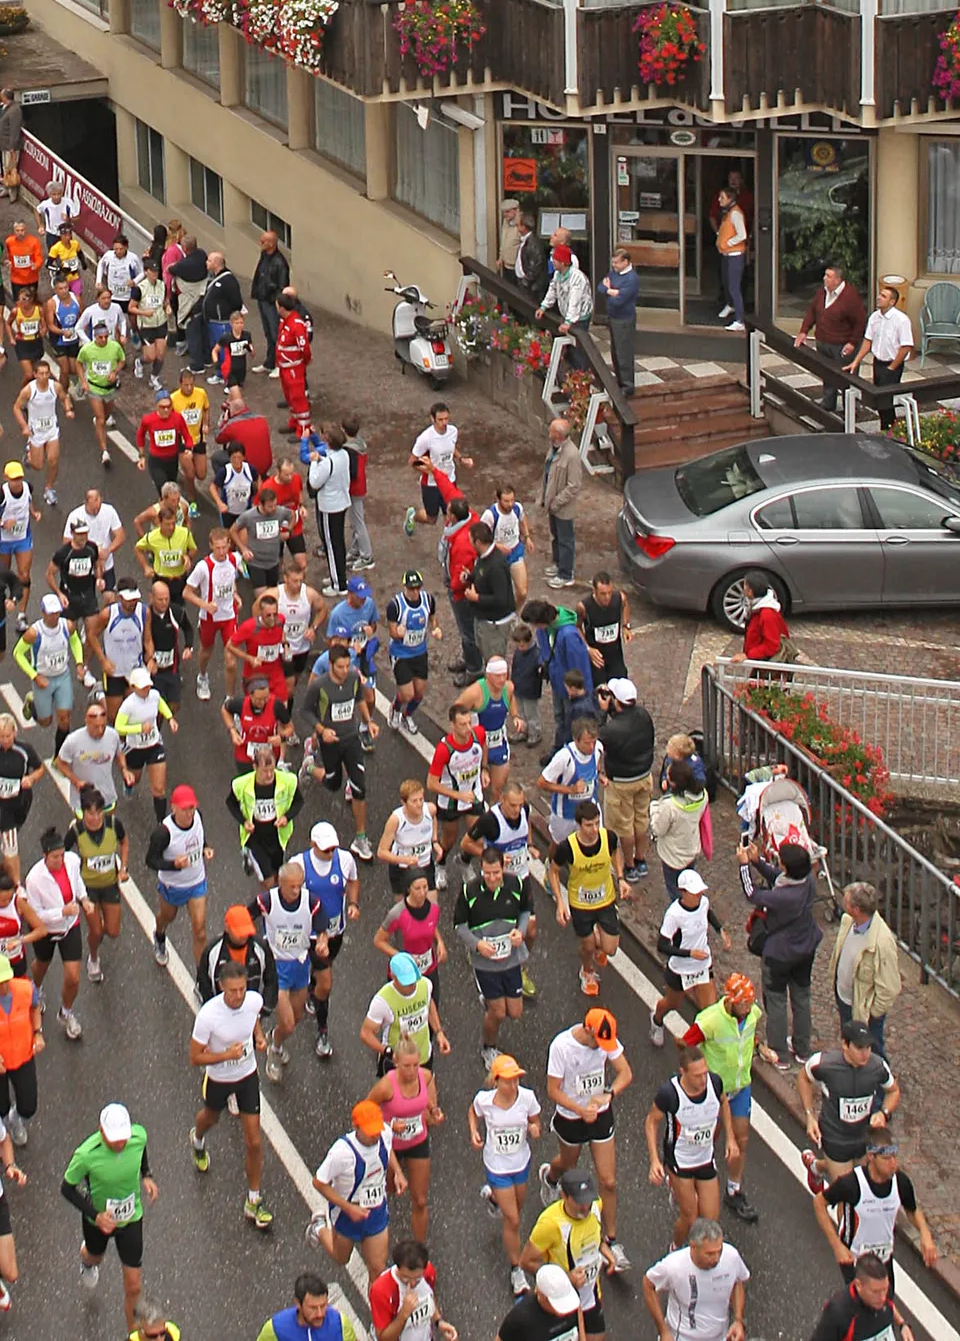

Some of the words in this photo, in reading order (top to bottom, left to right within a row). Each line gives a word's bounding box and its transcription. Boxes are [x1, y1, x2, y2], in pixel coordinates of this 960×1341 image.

[407, 1015, 423, 1027] 961
[582, 1076, 602, 1090] 1393
[497, 1134, 520, 1145] 1392
[694, 1130, 711, 1141] 670
[365, 1187, 381, 1198] 141
